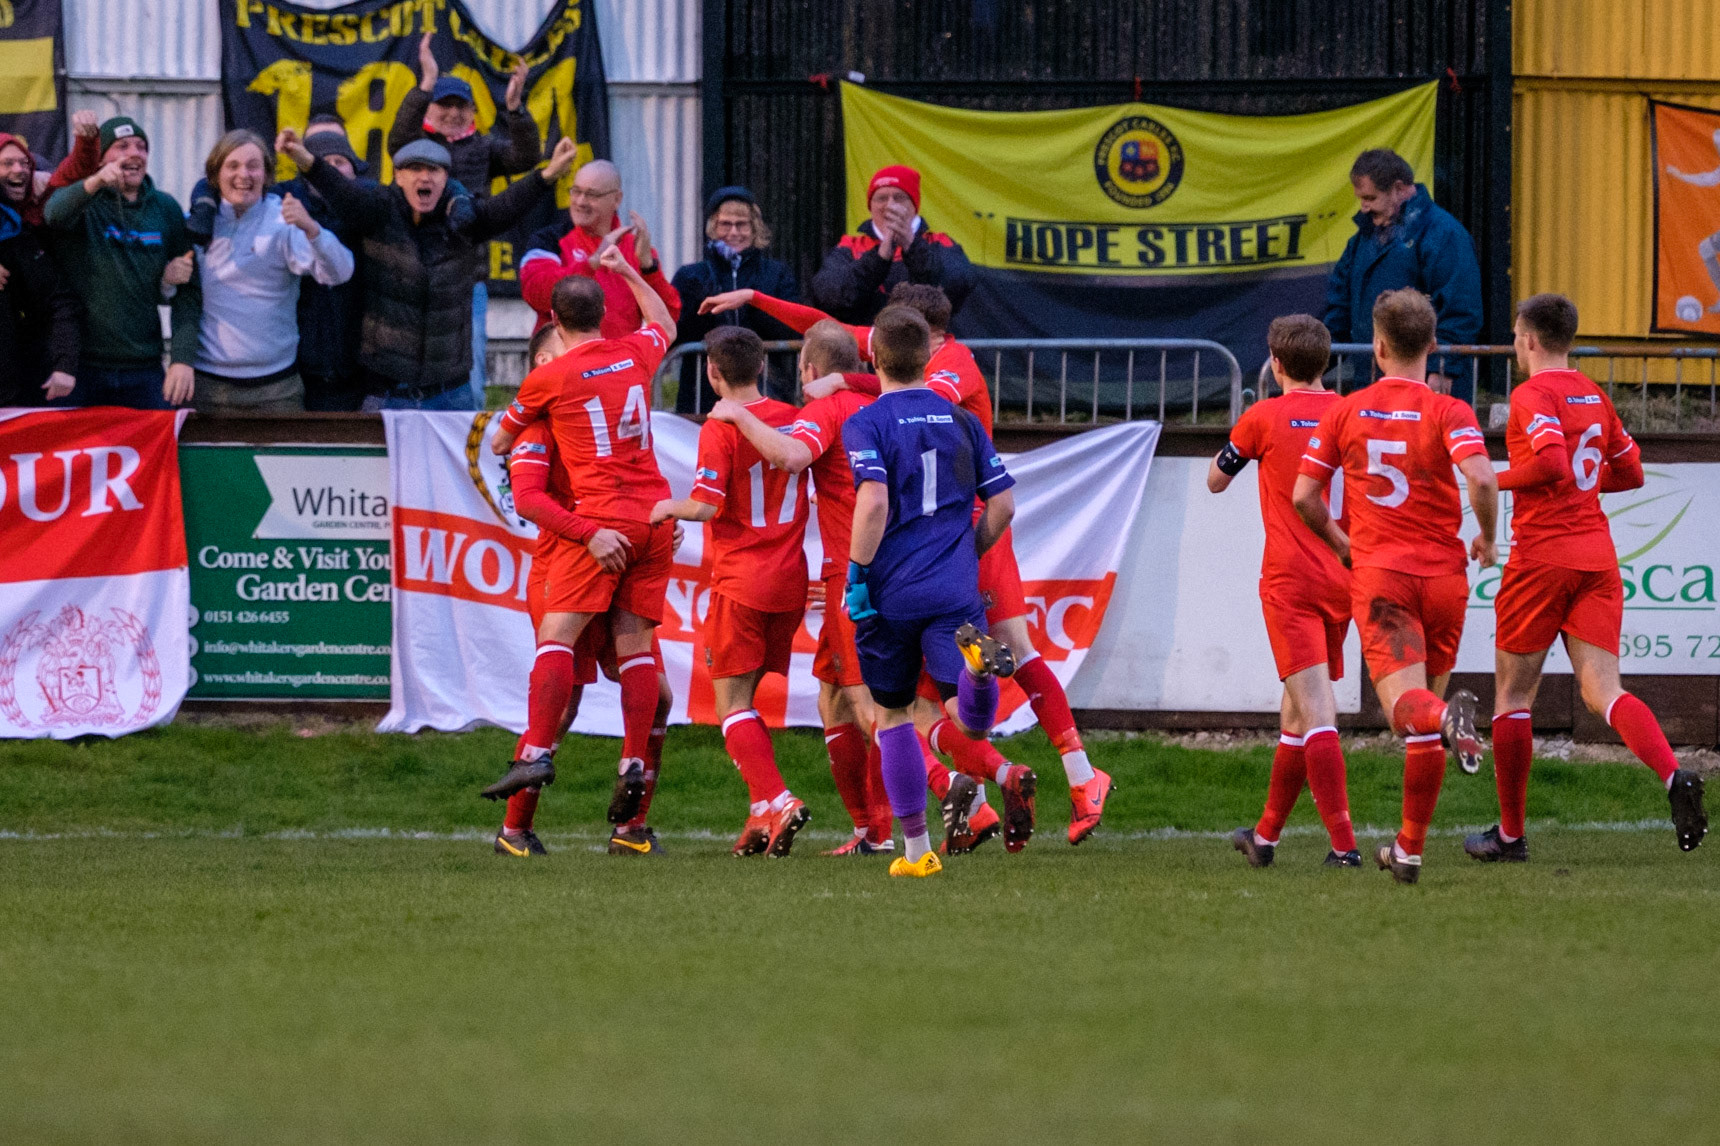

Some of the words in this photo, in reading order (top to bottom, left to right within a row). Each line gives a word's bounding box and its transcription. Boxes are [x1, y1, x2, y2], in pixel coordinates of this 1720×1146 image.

[1006, 220, 1121, 266] HOPE
[1137, 214, 1308, 269] STREET
[582, 384, 650, 456] 14
[0, 445, 144, 522] UR
[921, 448, 938, 517] 1
[1365, 438, 1410, 508] 5
[1572, 423, 1602, 491] 6
[292, 486, 388, 517] Whita
[198, 545, 269, 569] Come
[272, 546, 295, 569] &
[297, 547, 350, 570] Visit
[236, 573, 339, 601] Garden
[203, 611, 233, 623] 0151
